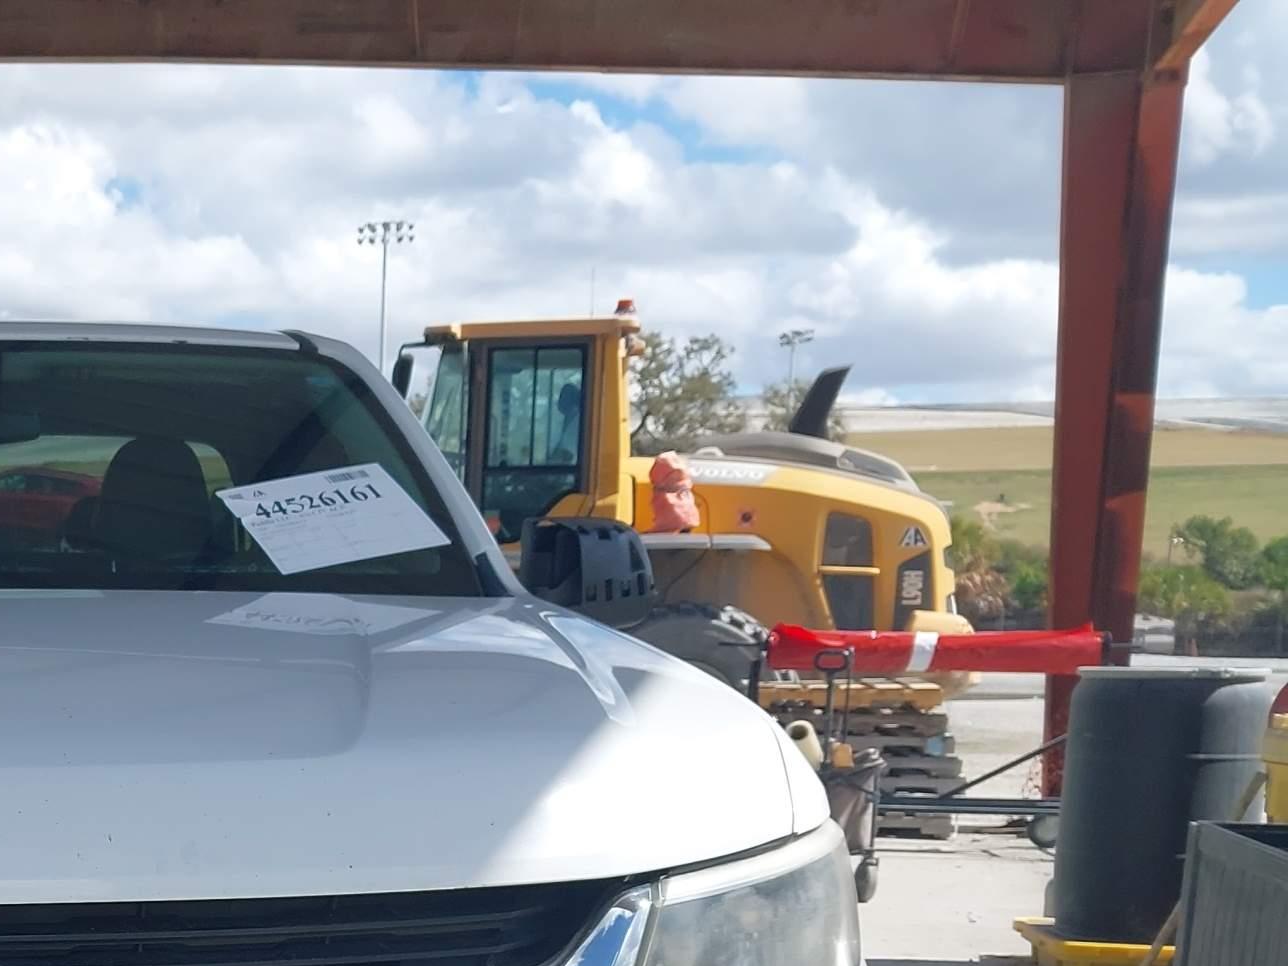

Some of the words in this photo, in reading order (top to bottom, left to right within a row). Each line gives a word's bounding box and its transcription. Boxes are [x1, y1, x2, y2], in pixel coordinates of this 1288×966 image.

[690, 466, 765, 478] VOLVO
[255, 483, 383, 519] 44526161
[901, 569, 924, 606] L90H
